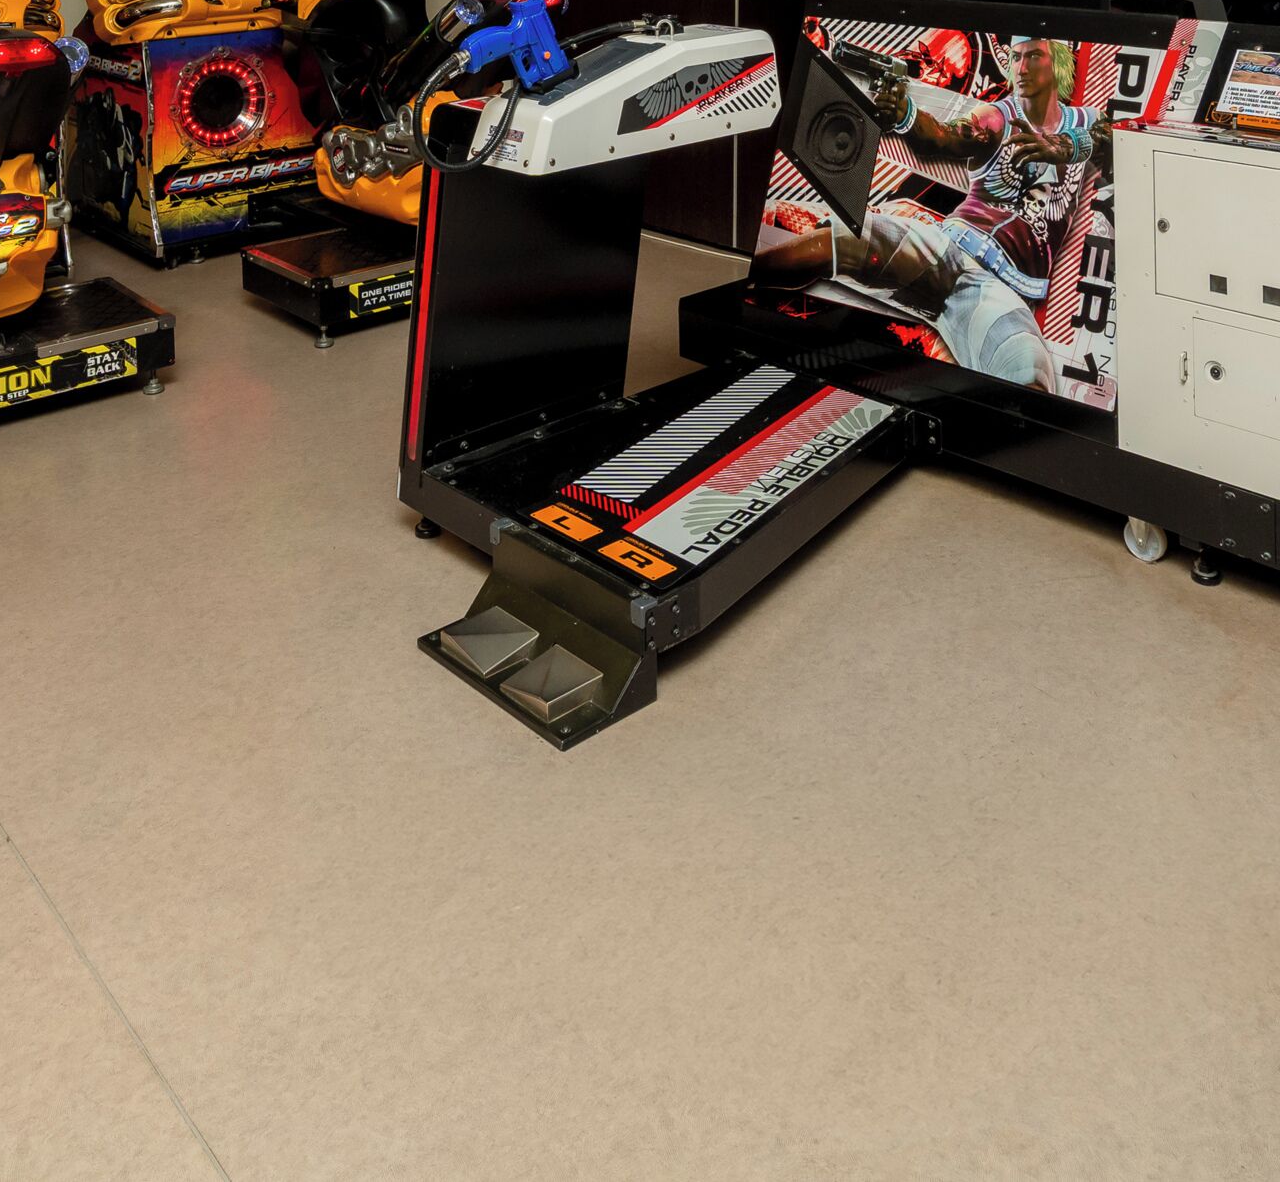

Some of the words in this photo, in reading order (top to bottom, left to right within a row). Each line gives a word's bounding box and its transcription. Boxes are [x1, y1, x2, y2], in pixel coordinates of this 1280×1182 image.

[128, 59, 142, 81] 2
[1170, 44, 1197, 102] PLAYER
[1238, 63, 1261, 72] TIME
[699, 78, 744, 108] PLAYER
[168, 165, 248, 192] SUPER
[248, 156, 314, 180] BIKES
[12, 218, 38, 235] 2
[361, 286, 382, 299] ONE
[384, 281, 413, 294] RIDER
[363, 298, 378, 307] AT
[378, 295, 387, 304] A
[389, 290, 412, 302] TIME
[86, 362, 120, 377] BACK
[87, 351, 119, 367] STAY
[1062, 352, 1099, 386] 1
[1094, 354, 1112, 398] Neil
[7, 389, 29, 401] STEP
[750, 431, 837, 495] SYSTEM
[767, 435, 854, 497] DOUBLE
[552, 515, 572, 531] L
[680, 498, 772, 555] PEDAL
[619, 550, 654, 570] R
